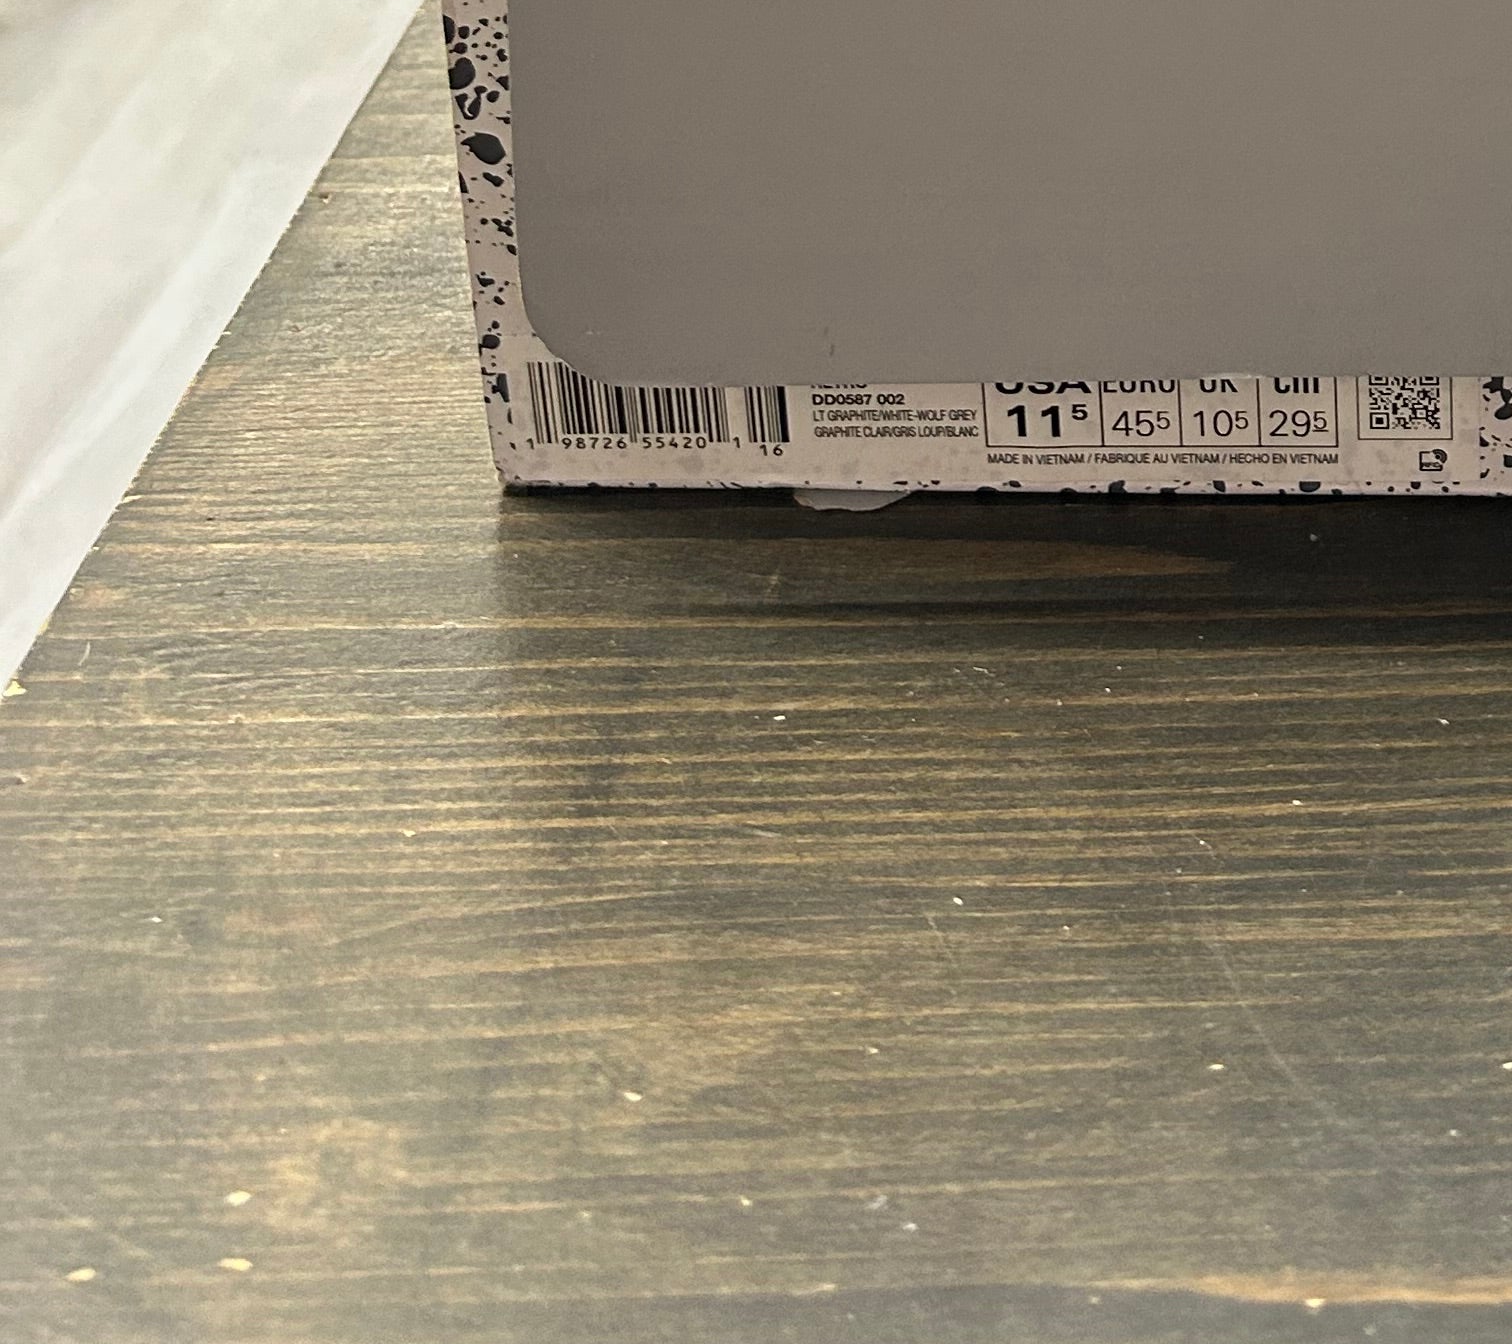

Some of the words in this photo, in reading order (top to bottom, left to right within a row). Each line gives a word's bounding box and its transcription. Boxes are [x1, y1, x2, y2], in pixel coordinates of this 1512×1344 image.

[812, 394, 872, 406] DD0587
[877, 394, 905, 406] 002
[813, 410, 825, 422] LT
[948, 409, 977, 422] GREY
[814, 425, 862, 438] GRAPHITE
[562, 436, 628, 450] 98726
[642, 435, 707, 450] 55420
[759, 443, 784, 457] 16
[987, 453, 1018, 464] MADE
[1022, 454, 1033, 464] IN
[1036, 454, 1085, 465] VIETNAM
[1094, 453, 1150, 464] FABRIQUE
[1153, 453, 1168, 464] AU
[1171, 453, 1220, 464] VIETNAM
[1229, 453, 1270, 464] HECHO
[1272, 453, 1287, 464] EN
[1289, 453, 1339, 464] VIETNAM
